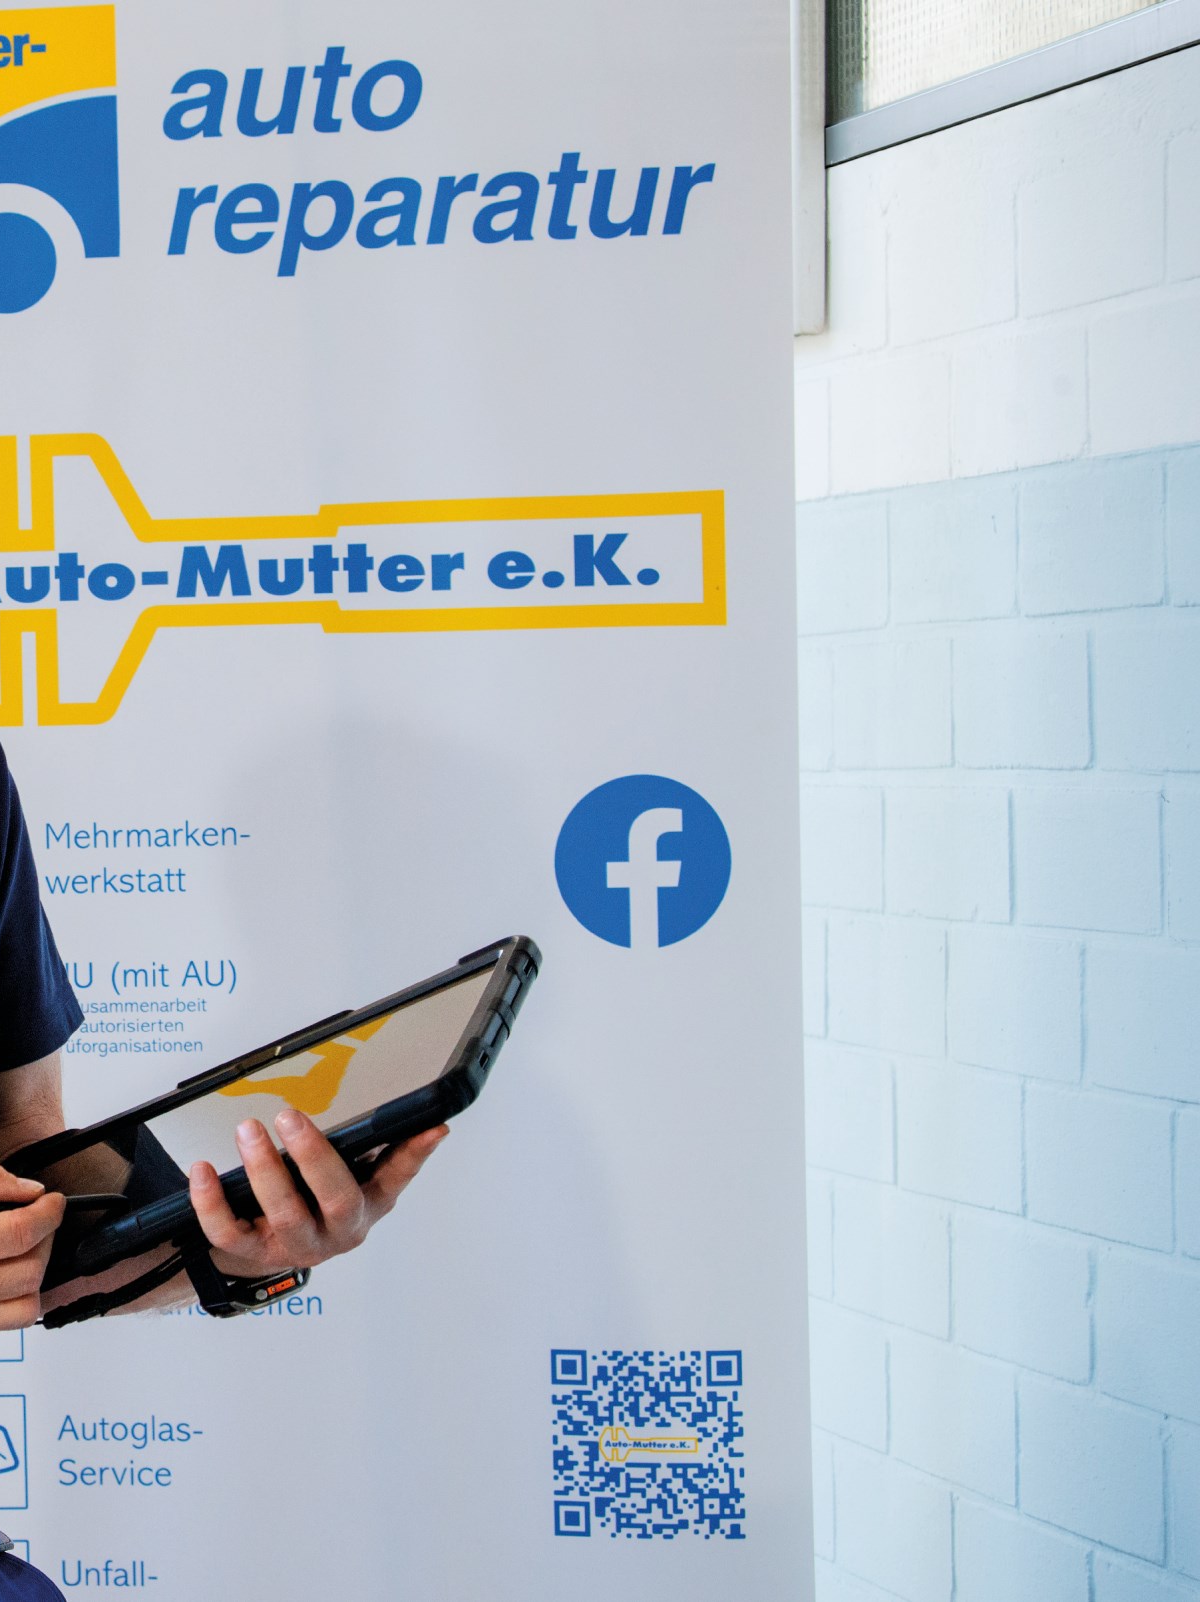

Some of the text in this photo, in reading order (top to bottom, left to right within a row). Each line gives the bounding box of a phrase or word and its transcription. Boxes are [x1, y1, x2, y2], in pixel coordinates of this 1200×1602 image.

[162, 45, 423, 141] auto
[167, 151, 717, 278] reparatur
[487, 532, 662, 591] e.K.
[45, 819, 251, 850] Mehrmarken-
[44, 867, 187, 895] werkstatt
[65, 959, 237, 996] U (mit AU)
[81, 998, 208, 1014] usammenarbeit
[79, 1018, 184, 1034] autorisierten
[66, 1037, 204, 1058] üforganisationen
[57, 1414, 204, 1450] Autoglas-
[605, 1440, 668, 1449] Auto-Mutter
[58, 1458, 173, 1487] Service
[61, 1559, 159, 1588] Unfall-
